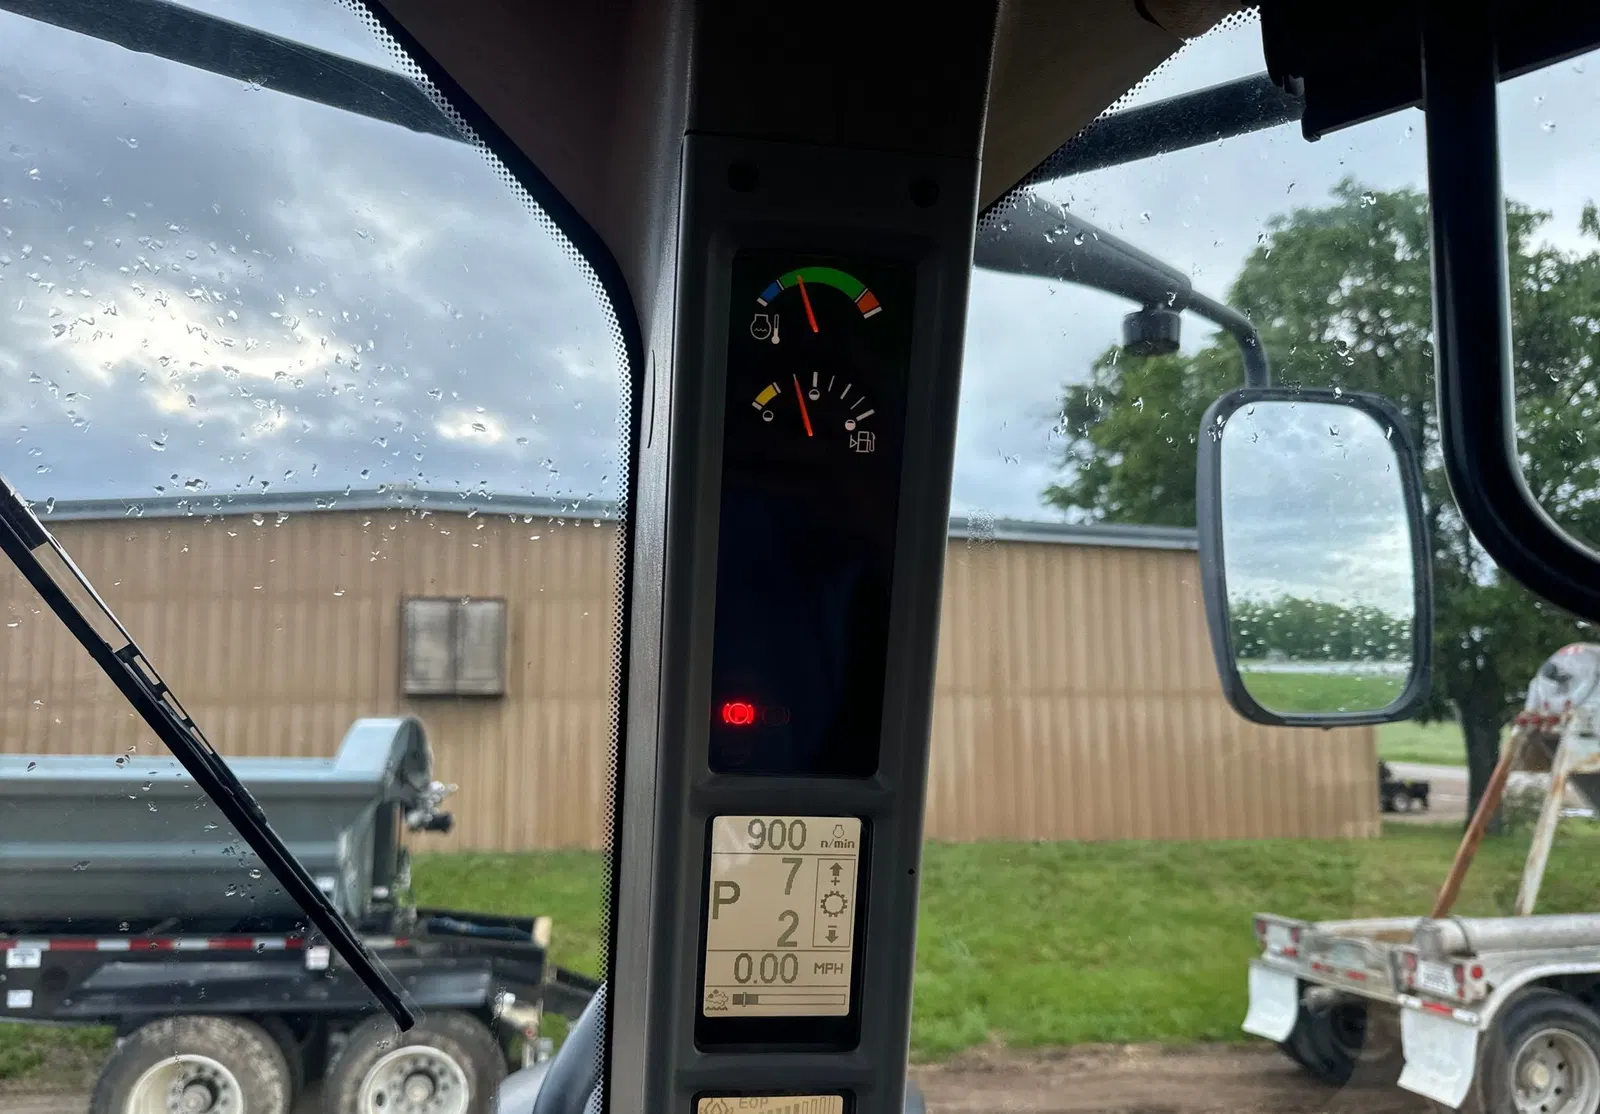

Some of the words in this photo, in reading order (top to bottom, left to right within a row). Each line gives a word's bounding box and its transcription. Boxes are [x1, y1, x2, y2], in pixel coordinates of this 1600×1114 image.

[748, 819, 807, 850] 900
[820, 838, 855, 849] n/min
[781, 857, 803, 895] 7
[712, 880, 741, 920] P
[776, 909, 800, 948] 2
[733, 952, 799, 984] 0.00
[813, 962, 844, 975] MPH
